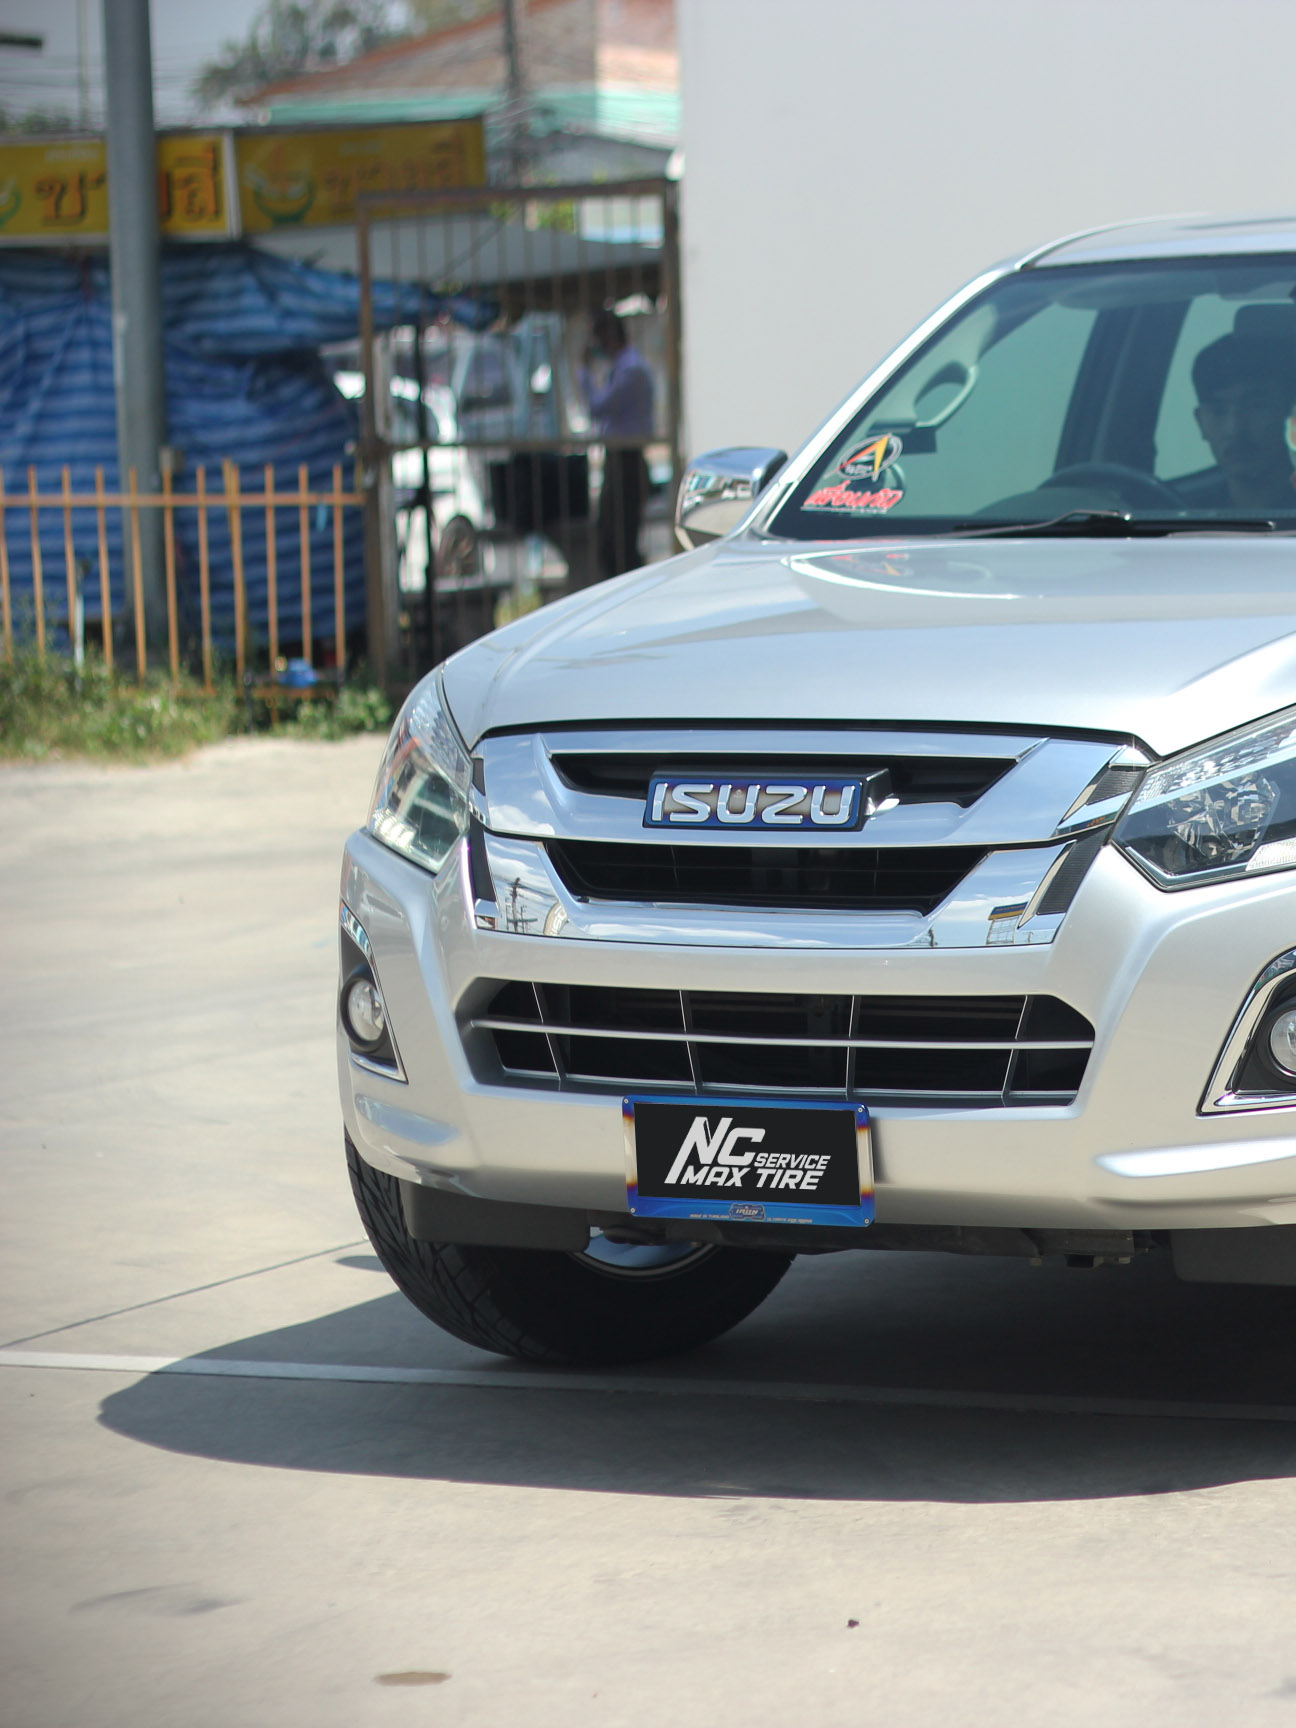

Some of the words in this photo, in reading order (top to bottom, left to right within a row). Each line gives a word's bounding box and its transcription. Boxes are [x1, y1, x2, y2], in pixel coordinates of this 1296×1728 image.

[651, 782, 856, 825] ISUZU
[664, 1116, 766, 1185] NC
[753, 1152, 832, 1171] SERVICE
[680, 1164, 751, 1188] MAX
[756, 1168, 825, 1191] TIRE
